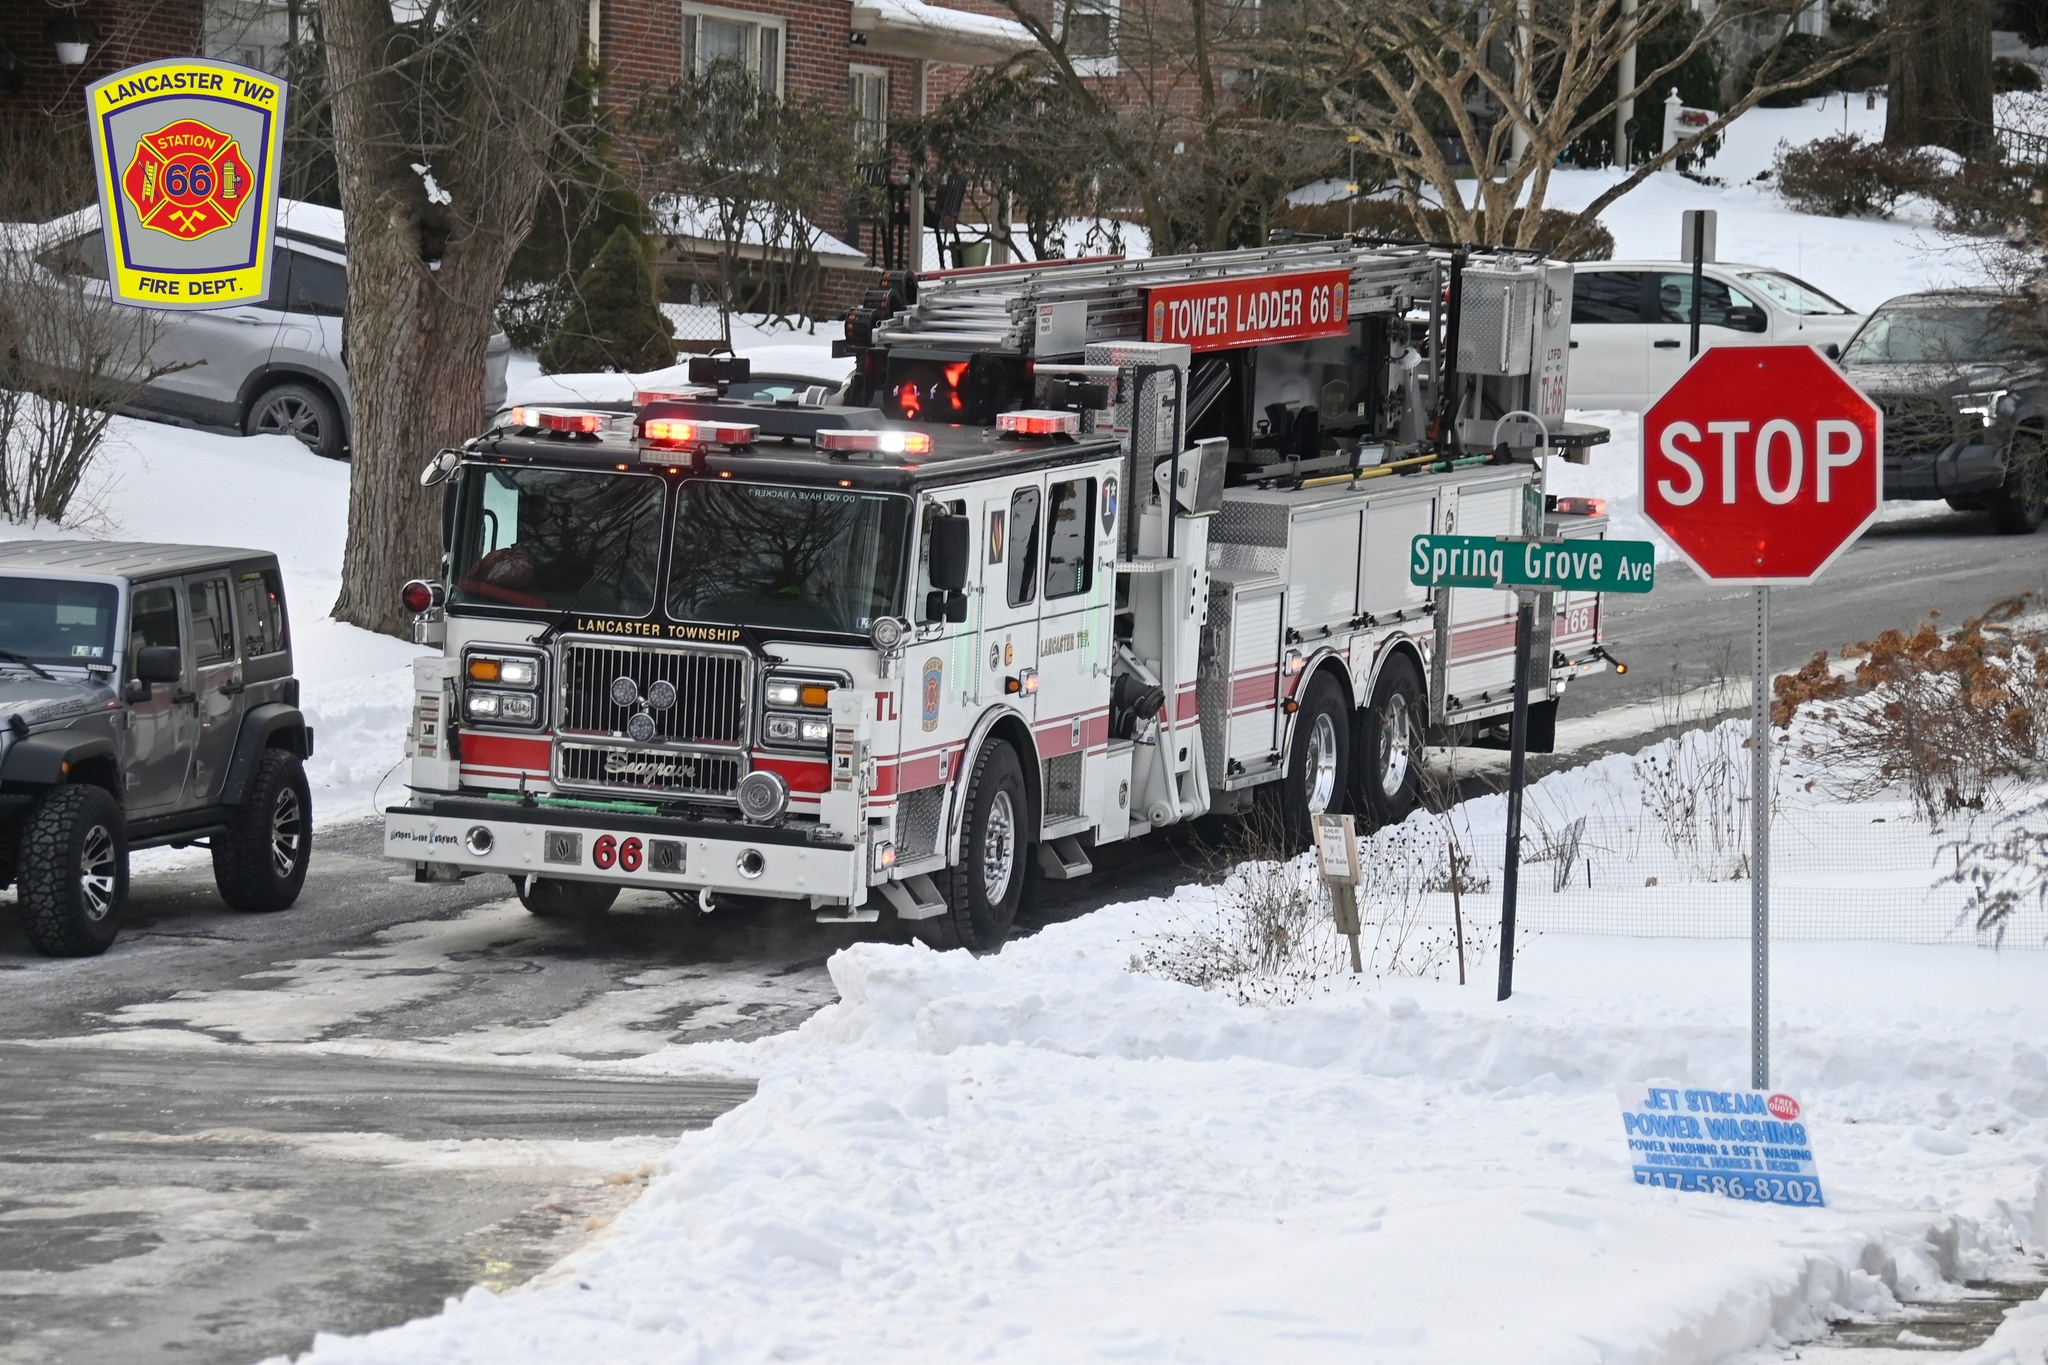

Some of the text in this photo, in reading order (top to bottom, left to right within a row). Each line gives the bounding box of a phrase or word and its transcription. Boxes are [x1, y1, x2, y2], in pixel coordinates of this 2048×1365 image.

[1169, 284, 1330, 340] TOWER LADDER 66
[1547, 348, 1562, 361] LTFD
[1541, 375, 1563, 415] TL-66
[1657, 418, 1863, 507] STOP
[1413, 538, 1652, 584] Spring Grove Ave
[578, 618, 740, 642] LANCASTER TOWNSHIP
[1040, 632, 1075, 658] LANCASTER
[874, 691, 898, 721] TL
[604, 752, 696, 785] Seagrave
[1323, 833, 1342, 842] Honey
[592, 834, 643, 872] 66
[1644, 1087, 1768, 1116] JET STREAM
[1769, 1103, 1799, 1116] QUOTES
[1774, 1097, 1794, 1107] FREE
[1623, 1112, 1807, 1146] POWER WASHING
[1628, 1139, 1812, 1161] POWER WASHING & SOFT WASHING
[1636, 1170, 1821, 1204] 717-586-8202
